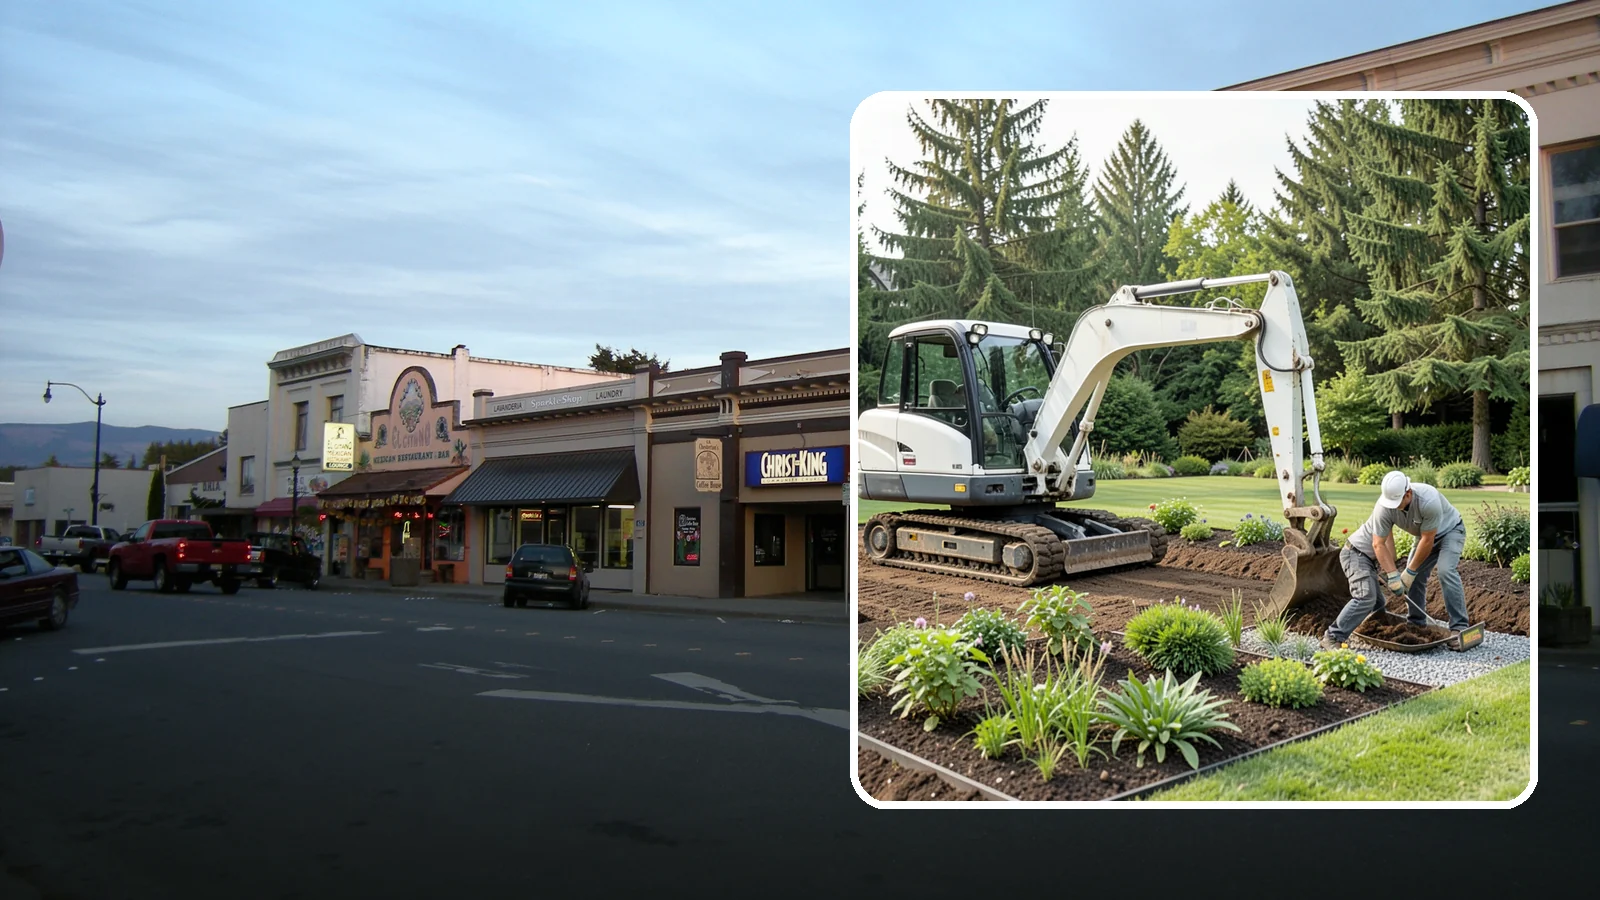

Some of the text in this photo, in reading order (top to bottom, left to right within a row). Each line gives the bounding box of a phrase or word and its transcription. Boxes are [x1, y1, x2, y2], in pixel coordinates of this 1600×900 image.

[561, 394, 583, 405] Shop
[595, 388, 624, 400] LAUNDRY
[493, 401, 523, 413] LAVANDERIA
[392, 425, 402, 449] EL
[373, 454, 396, 464] MEXICAN
[397, 451, 434, 462] RESTAURANT
[437, 450, 450, 459] BAR
[760, 450, 827, 477] CHRIST KING
[697, 481, 722, 489] Coffee House
